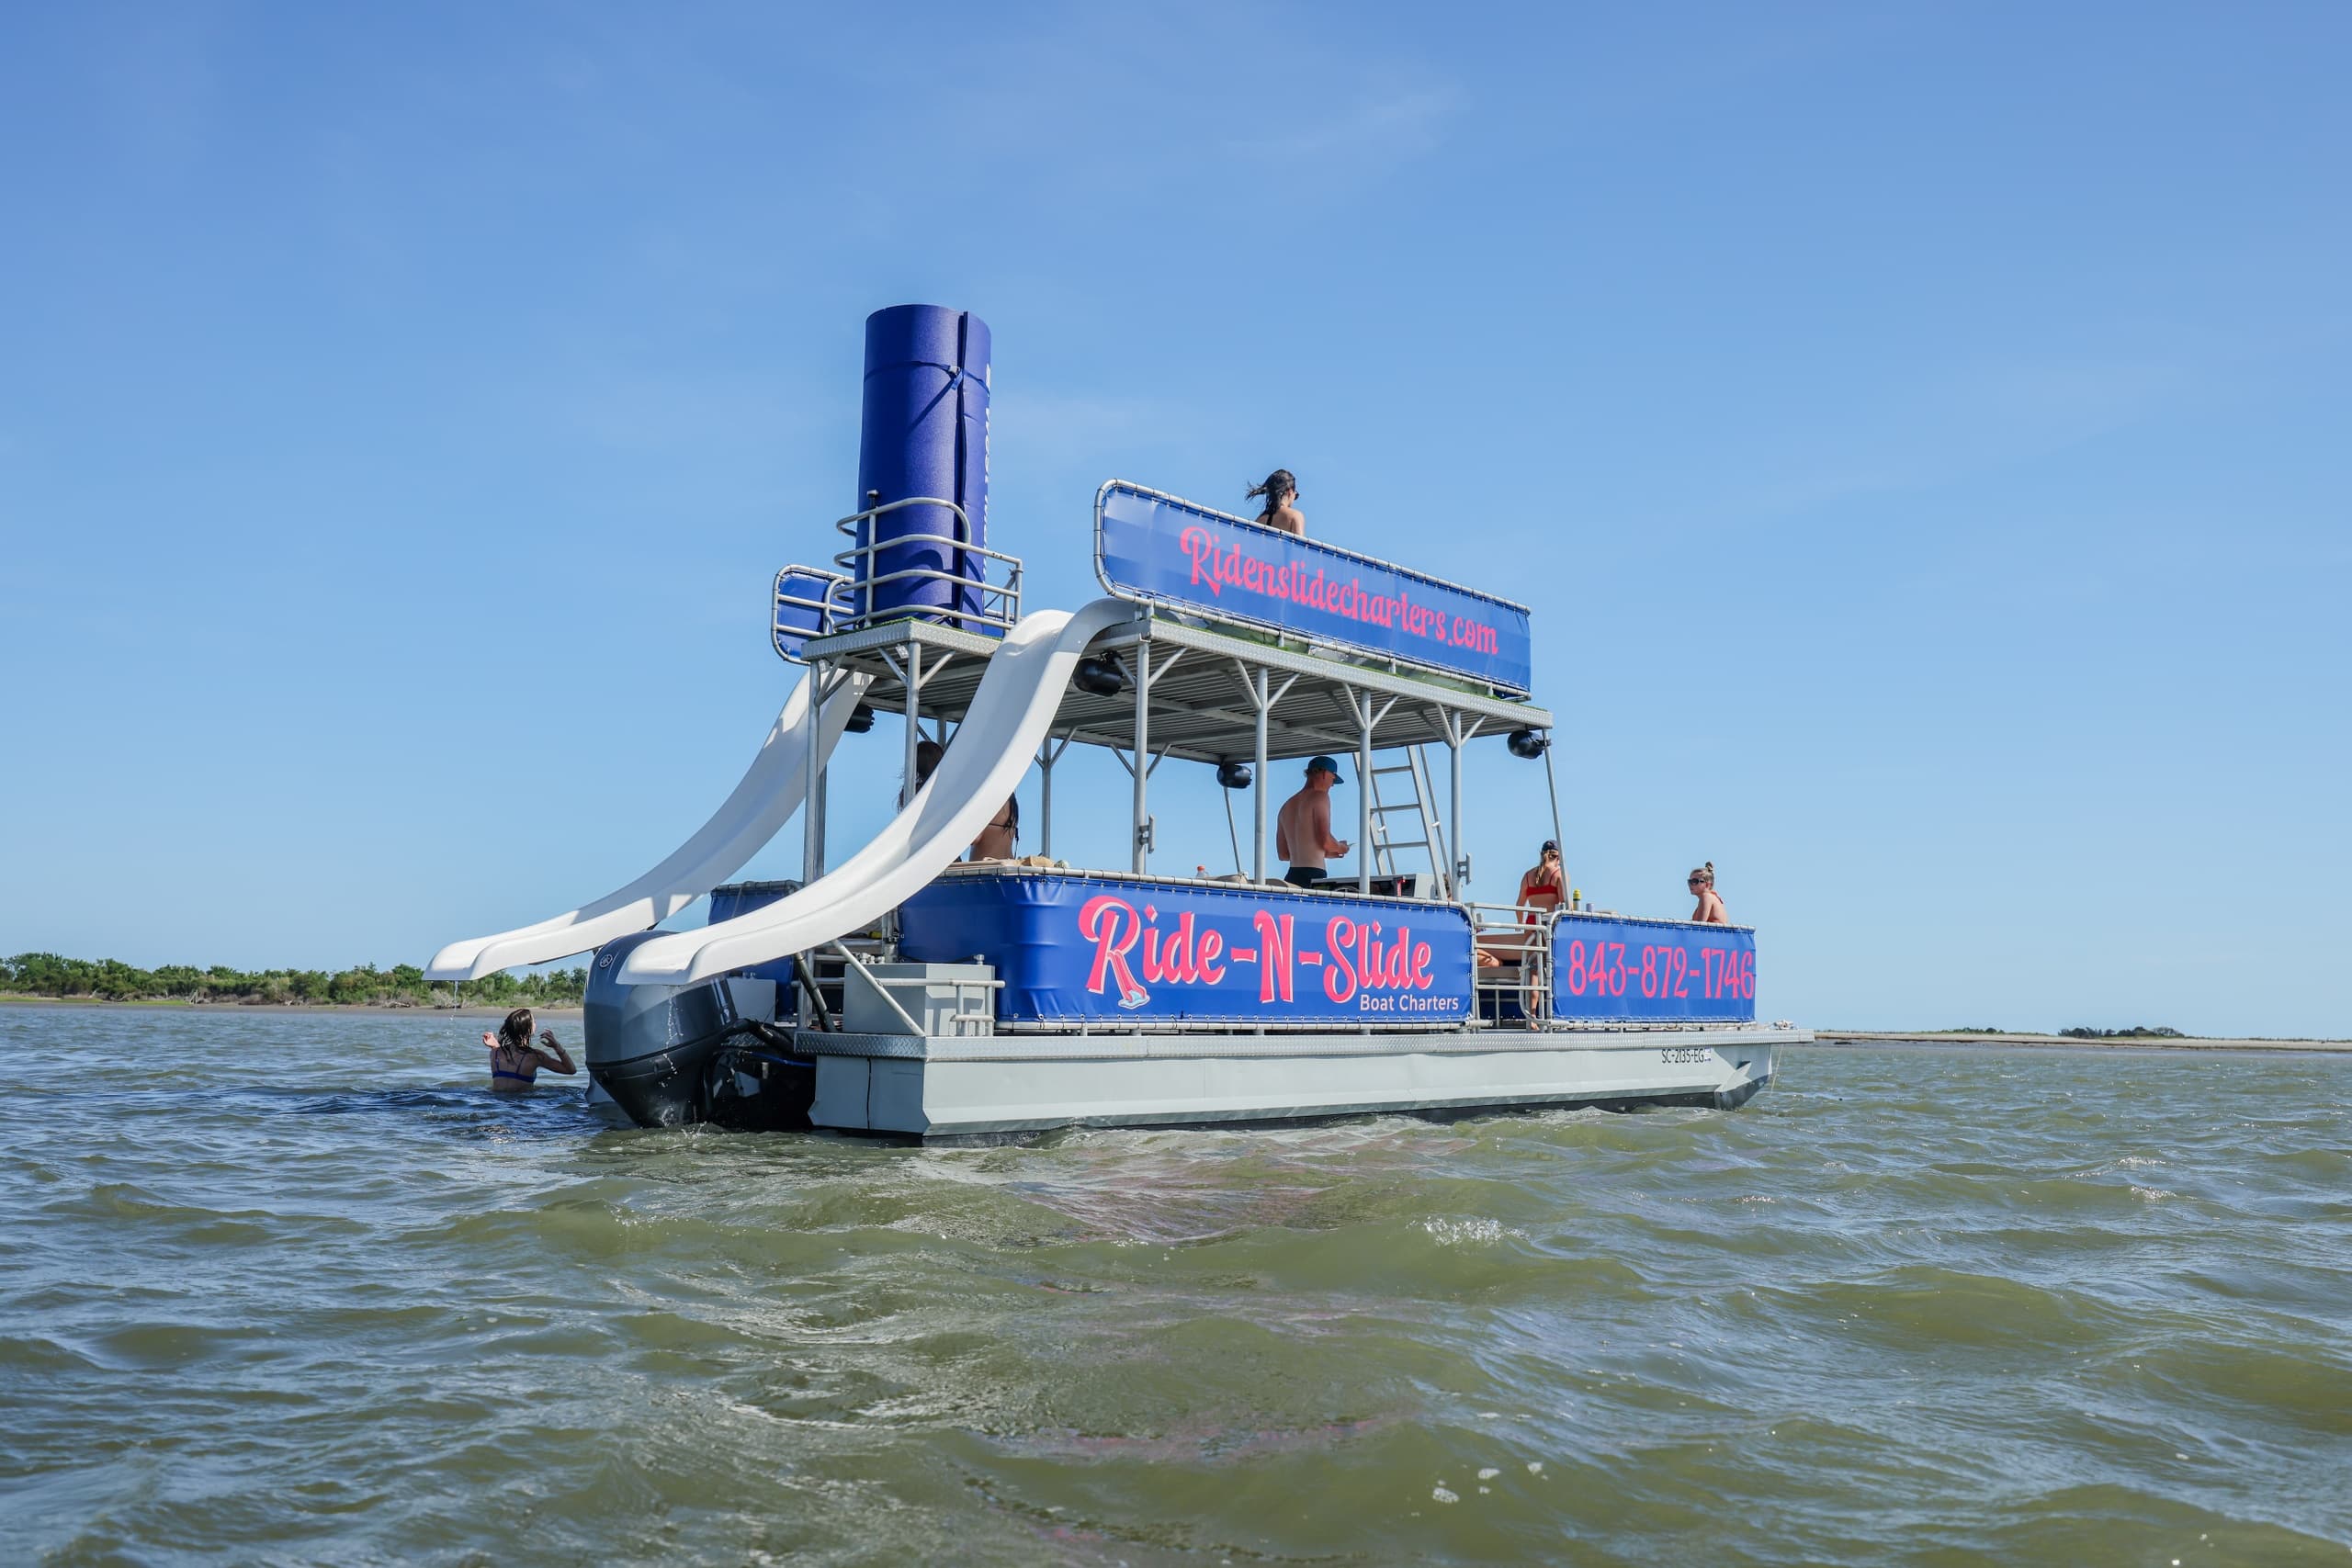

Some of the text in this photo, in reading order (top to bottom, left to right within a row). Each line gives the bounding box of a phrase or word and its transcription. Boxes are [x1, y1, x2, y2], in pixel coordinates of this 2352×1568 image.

[1181, 526, 1499, 655] Ridenslidecharters.com
[1078, 895, 1435, 1006] Ride-N-Slide
[1568, 940, 1756, 999] 843-872-1746
[1360, 994, 1459, 1011] Boat Charters
